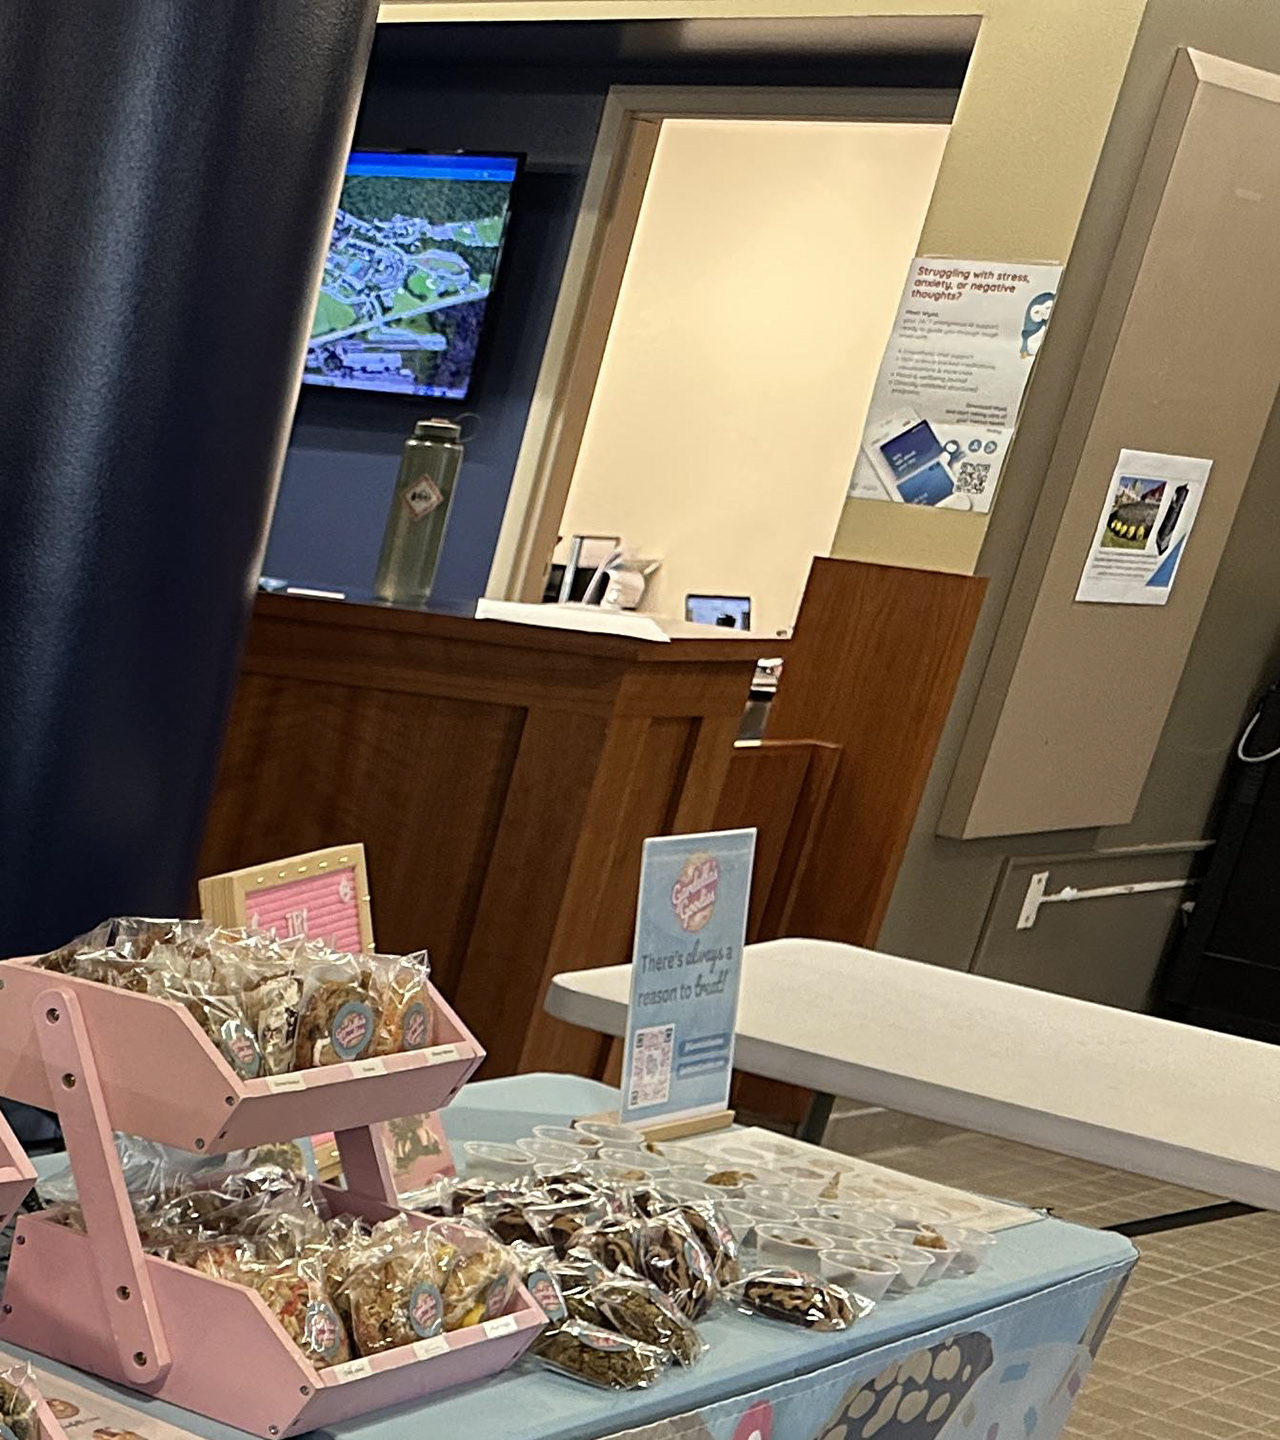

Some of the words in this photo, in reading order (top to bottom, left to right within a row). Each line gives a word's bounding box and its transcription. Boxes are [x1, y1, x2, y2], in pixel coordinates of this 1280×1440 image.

[916, 266, 971, 280] Struggling
[973, 269, 995, 280] with
[996, 271, 1030, 284] stress,
[913, 278, 954, 291] anxiety,
[956, 282, 968, 290] or
[970, 281, 1016, 294] negative
[911, 289, 963, 302] thoughts?
[641, 951, 684, 974] There's
[637, 984, 678, 1008] reason
[680, 983, 693, 1000] to
